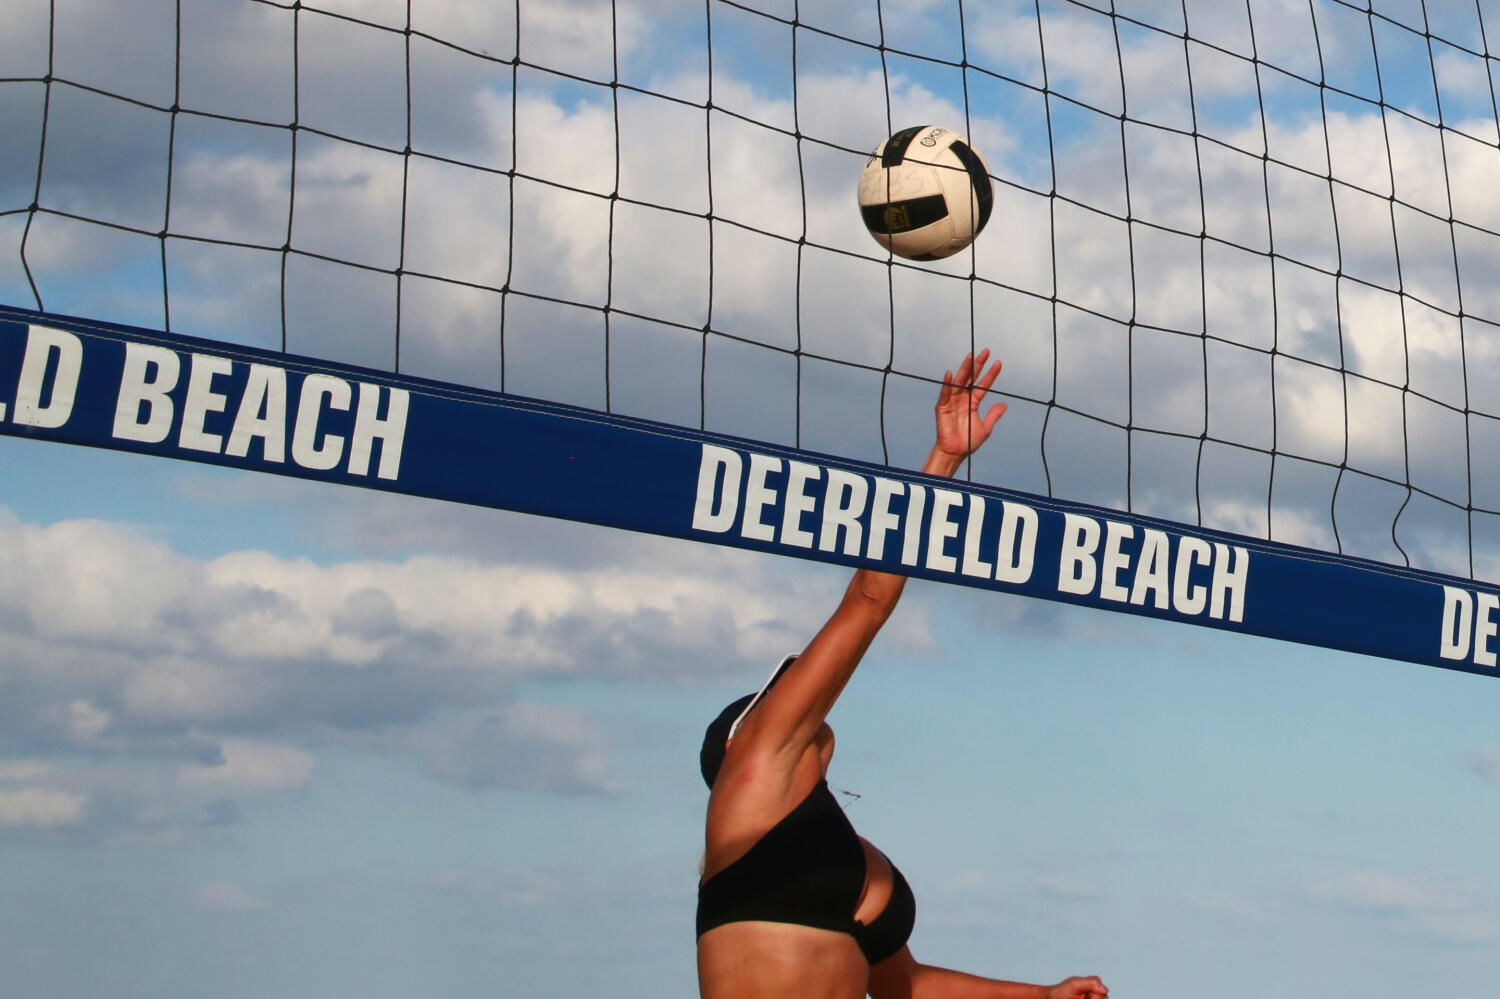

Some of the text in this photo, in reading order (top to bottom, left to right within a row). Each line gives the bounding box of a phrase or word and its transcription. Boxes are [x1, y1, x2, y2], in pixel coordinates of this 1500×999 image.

[112, 341, 410, 481] BEACH
[691, 443, 1249, 623] DEERFIELD BEACH
